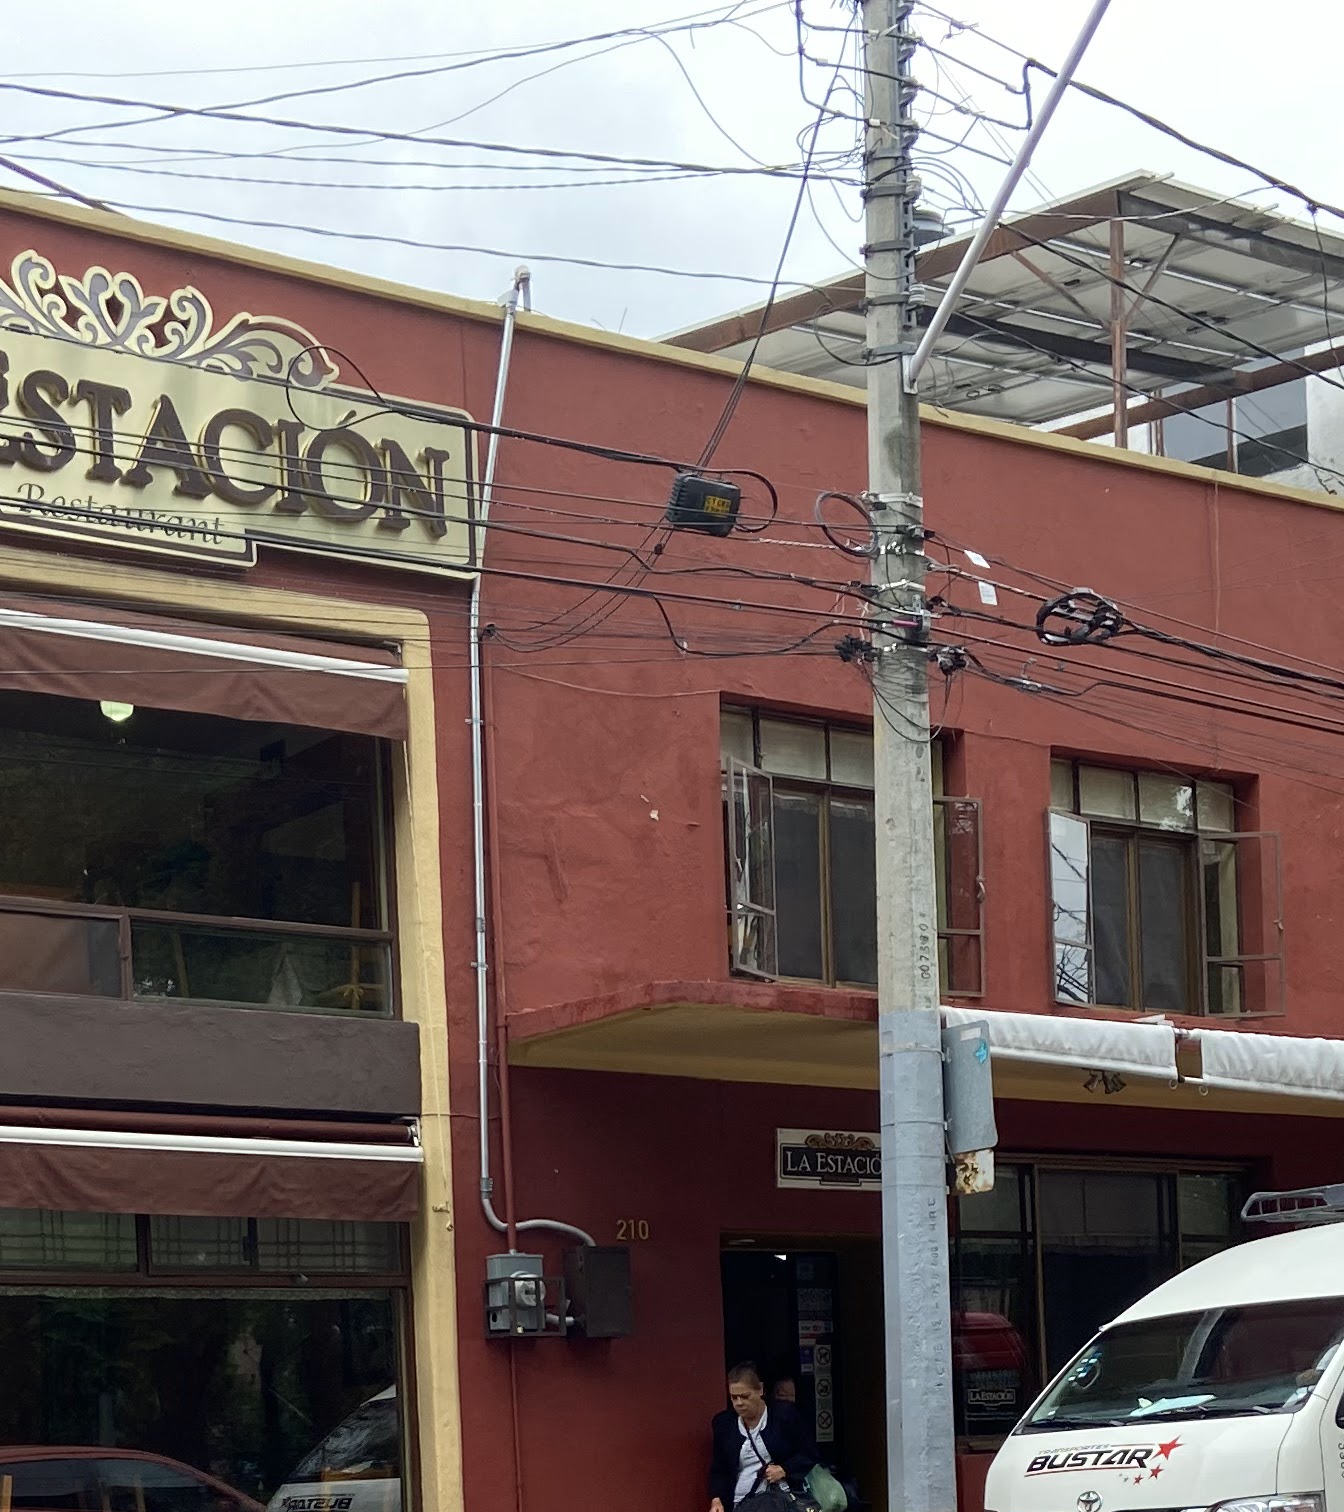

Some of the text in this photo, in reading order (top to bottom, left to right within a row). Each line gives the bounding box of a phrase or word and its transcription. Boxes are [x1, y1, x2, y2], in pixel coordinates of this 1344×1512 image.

[786, 1151, 811, 1172] LA
[616, 1219, 649, 1240] 210
[1026, 1448, 1154, 1473] BUSTAR
